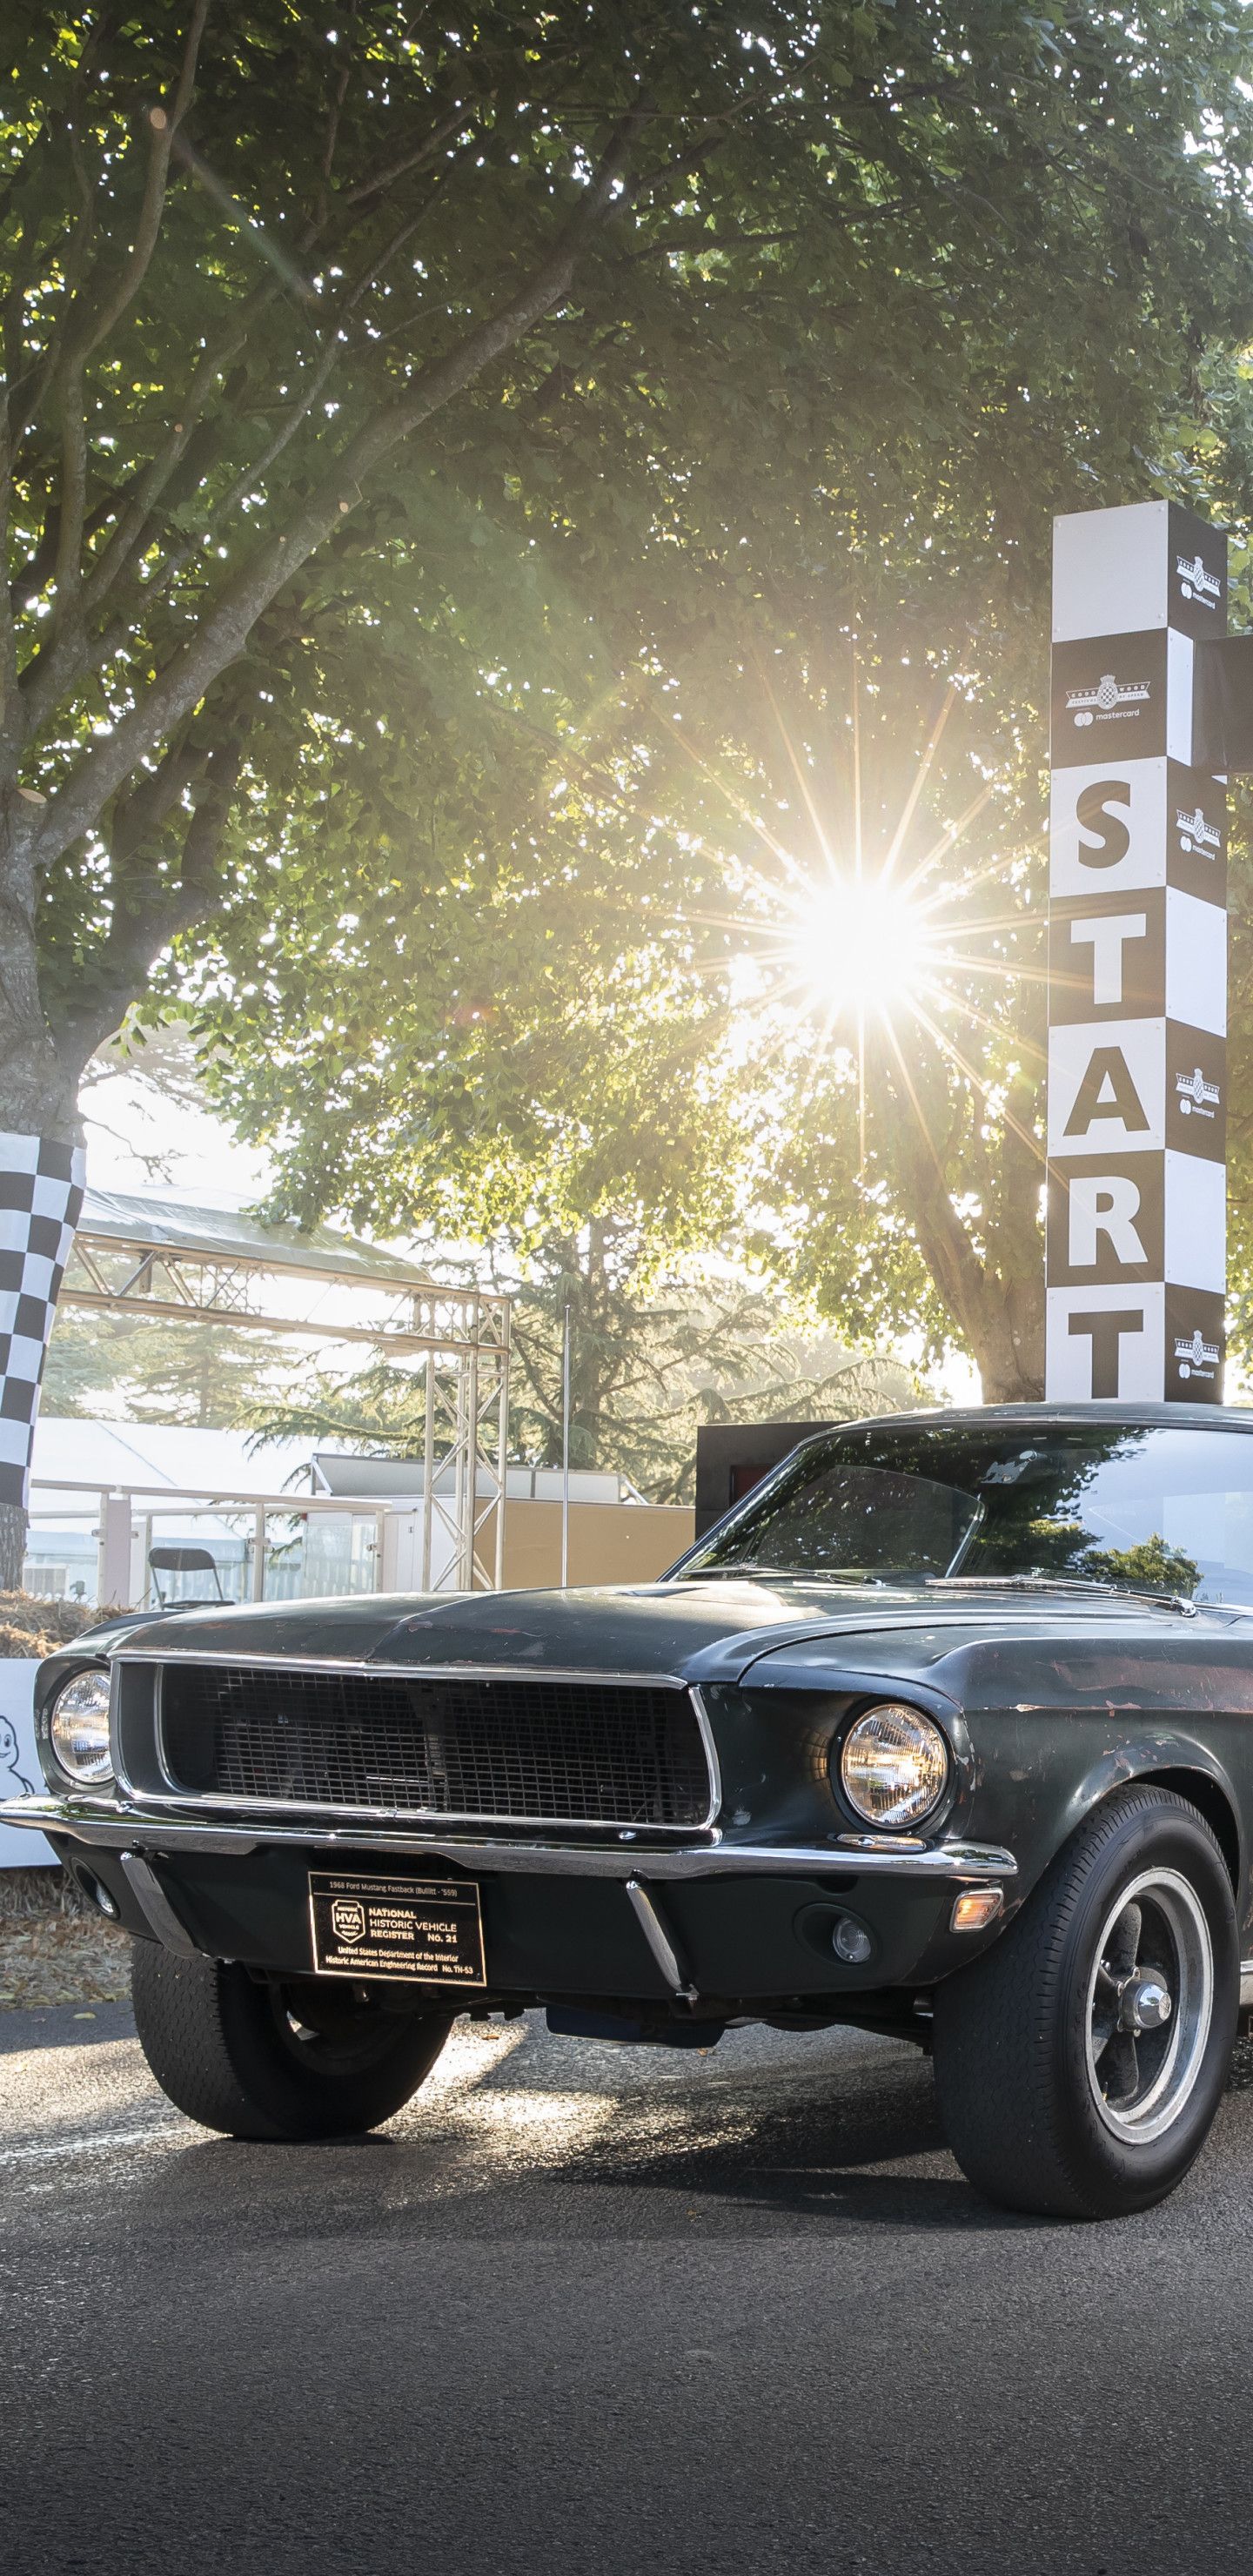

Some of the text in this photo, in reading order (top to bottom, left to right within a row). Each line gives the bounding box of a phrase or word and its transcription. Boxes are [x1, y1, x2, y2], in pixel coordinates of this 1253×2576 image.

[1096, 708, 1141, 721] mastercard
[1062, 780, 1151, 1399] START
[361, 1883, 387, 1893] Mustang
[388, 1885, 414, 1894] Fastback
[335, 1912, 362, 1924] HVA
[368, 1908, 417, 1919] NATIONAL
[370, 1919, 458, 1932] HISTORIC VEHICLE
[371, 1929, 415, 1941] REGISTER
[446, 1934, 458, 1943] 21
[338, 1946, 358, 1955] United
[358, 1948, 378, 1956] States
[379, 1949, 415, 1958] Department
[423, 1952, 434, 1961] the
[435, 1953, 459, 1962] Interior
[325, 1955, 349, 1965] Historic
[350, 1957, 379, 1968] American
[379, 1960, 416, 1971] Engineering
[417, 1962, 438, 1972] Record
